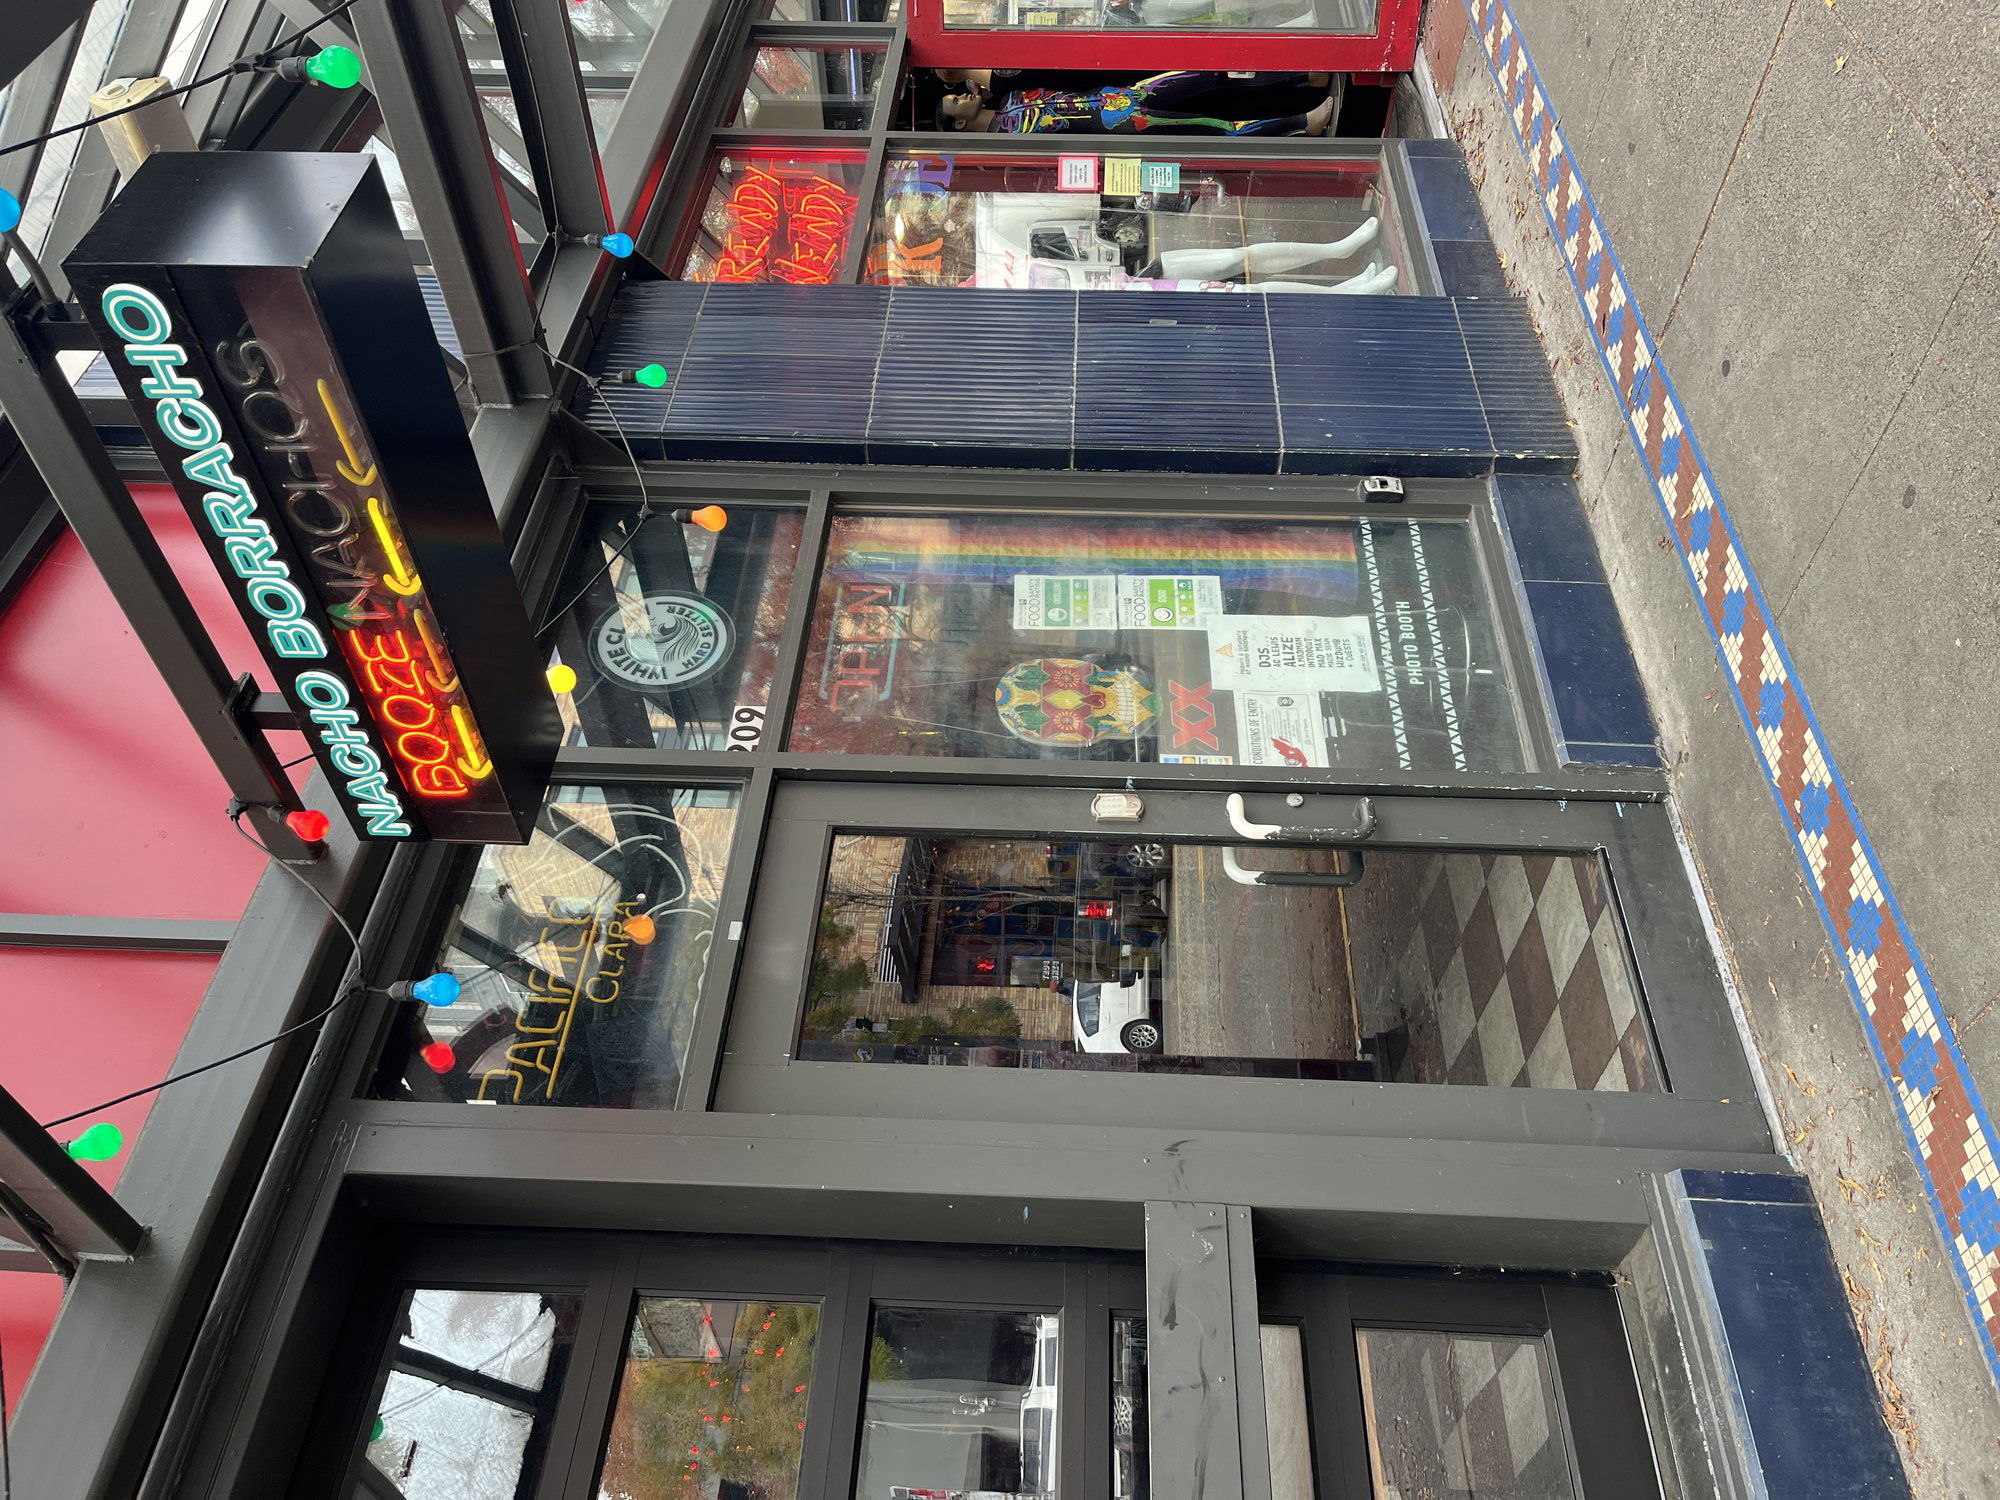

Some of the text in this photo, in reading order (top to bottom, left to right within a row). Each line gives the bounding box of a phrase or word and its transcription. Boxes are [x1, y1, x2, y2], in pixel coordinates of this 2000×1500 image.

[693, 165, 782, 284] RENDY
[215, 337, 391, 623] NACHOS
[101, 283, 413, 837] NACHO BORRACHO
[1028, 598, 1041, 627] FOOD
[1133, 597, 1146, 627] FOOD
[666, 605, 714, 669] HARD SELTZER
[1270, 637, 1280, 657] LEWIS
[1280, 637, 1297, 668] ALIZE
[1314, 638, 1327, 668] MAD MAX
[1342, 638, 1354, 662] GUESTS
[1395, 601, 1425, 685] PHOTO BOOTH
[606, 646, 669, 680] WHITE
[349, 629, 469, 795] BOOZE
[1168, 679, 1219, 751] XX
[1247, 697, 1259, 717] ENTRY
[1248, 718, 1260, 727] OF
[1249, 727, 1264, 764] CONDITIONS
